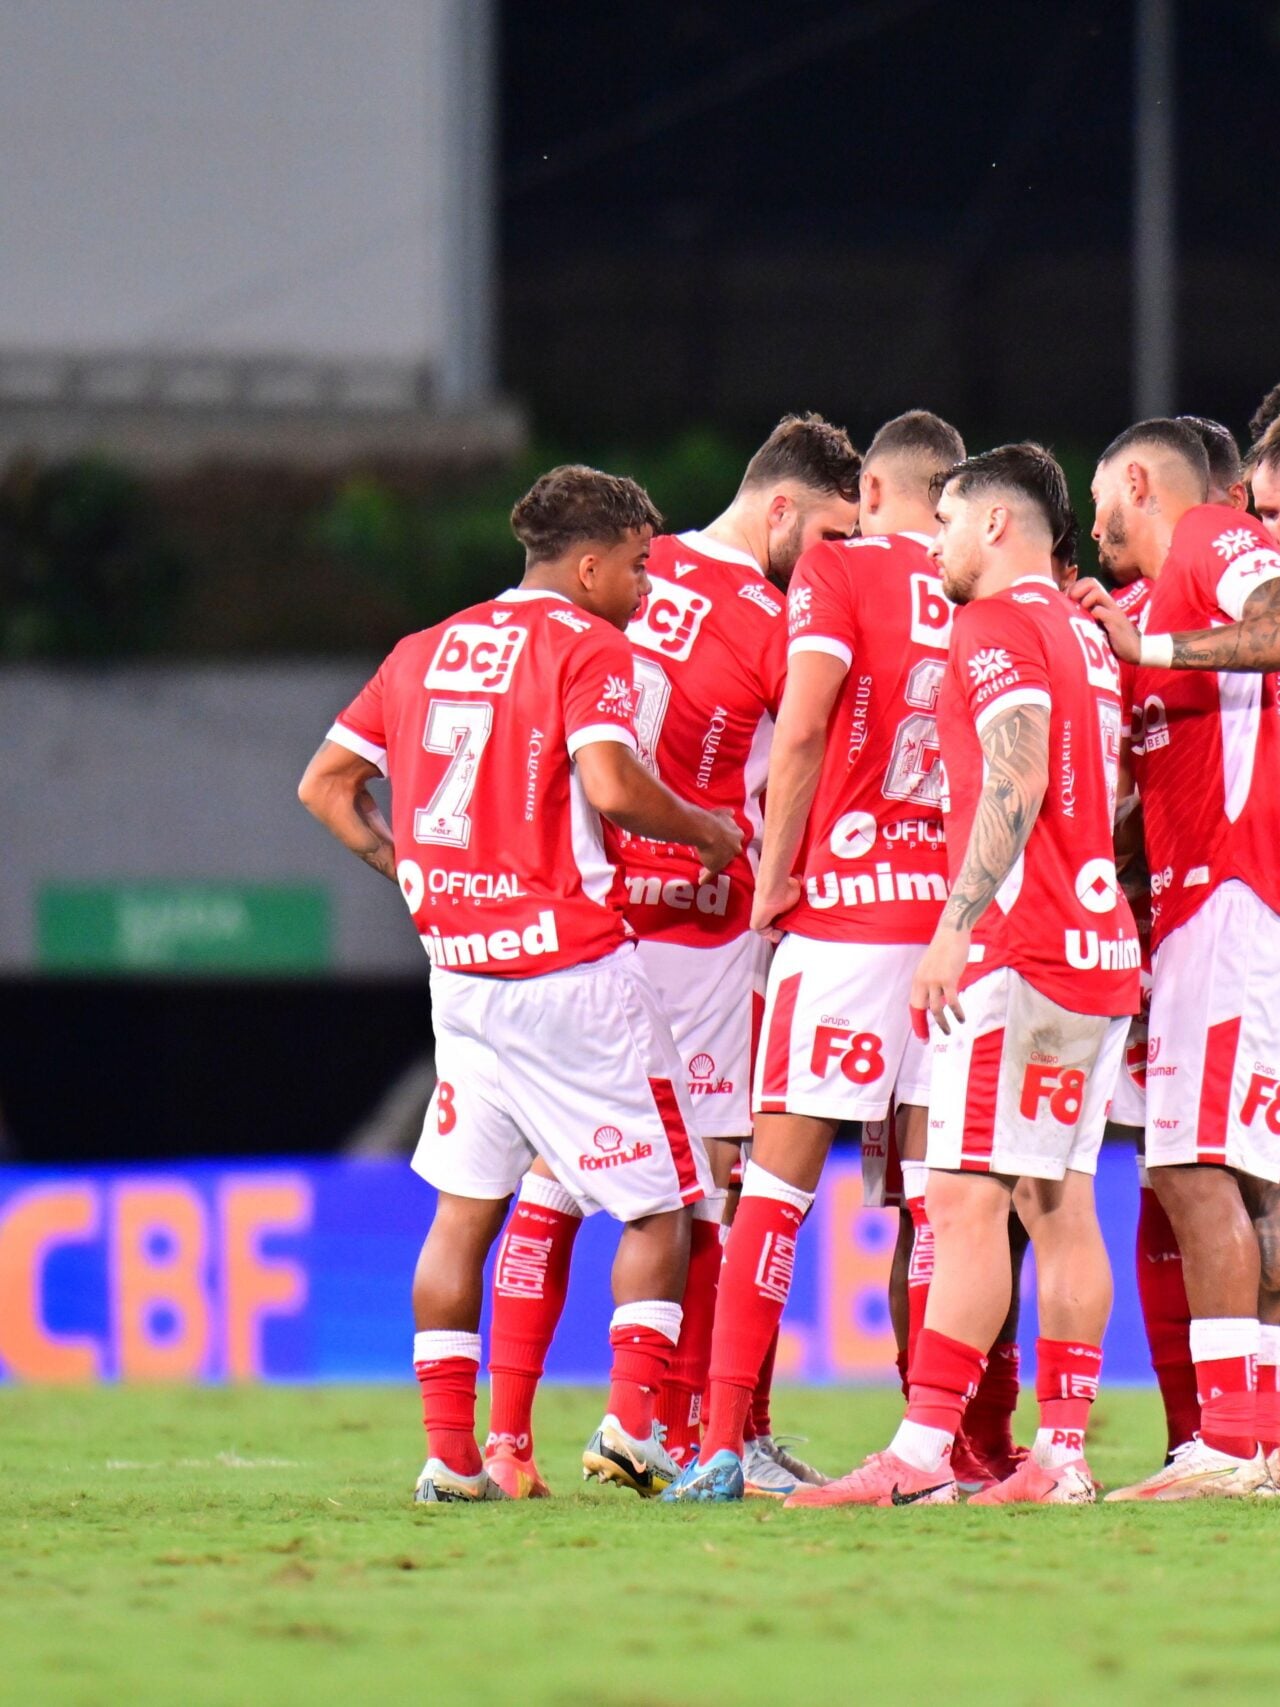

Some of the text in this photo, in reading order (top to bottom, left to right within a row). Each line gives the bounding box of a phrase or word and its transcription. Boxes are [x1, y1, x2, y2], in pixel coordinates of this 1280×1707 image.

[435, 630, 520, 688] bcj
[696, 705, 728, 789] AQUARIUS
[847, 675, 873, 770] QUARIUS
[1147, 734, 1167, 748] BET
[413, 699, 494, 850] 7
[525, 727, 544, 822] AQUARIUS
[1061, 720, 1075, 818] AQUARIUS
[886, 842, 938, 850] SPO
[428, 868, 527, 899] OFICIAL
[807, 862, 949, 909] Unim
[419, 910, 559, 966] nimed
[1065, 928, 1141, 970] Unim
[820, 1014, 850, 1027] Grupo
[810, 1025, 885, 1085] F8
[1030, 1051, 1059, 1064] Grupo
[436, 1081, 457, 1136] 8
[1019, 1064, 1086, 1126] F8
[0, 1180, 312, 1382] CBF
[495, 1233, 553, 1299] VEDACIL
[1146, 1252, 1182, 1263] VIL
[1051, 1430, 1085, 1451] PR
